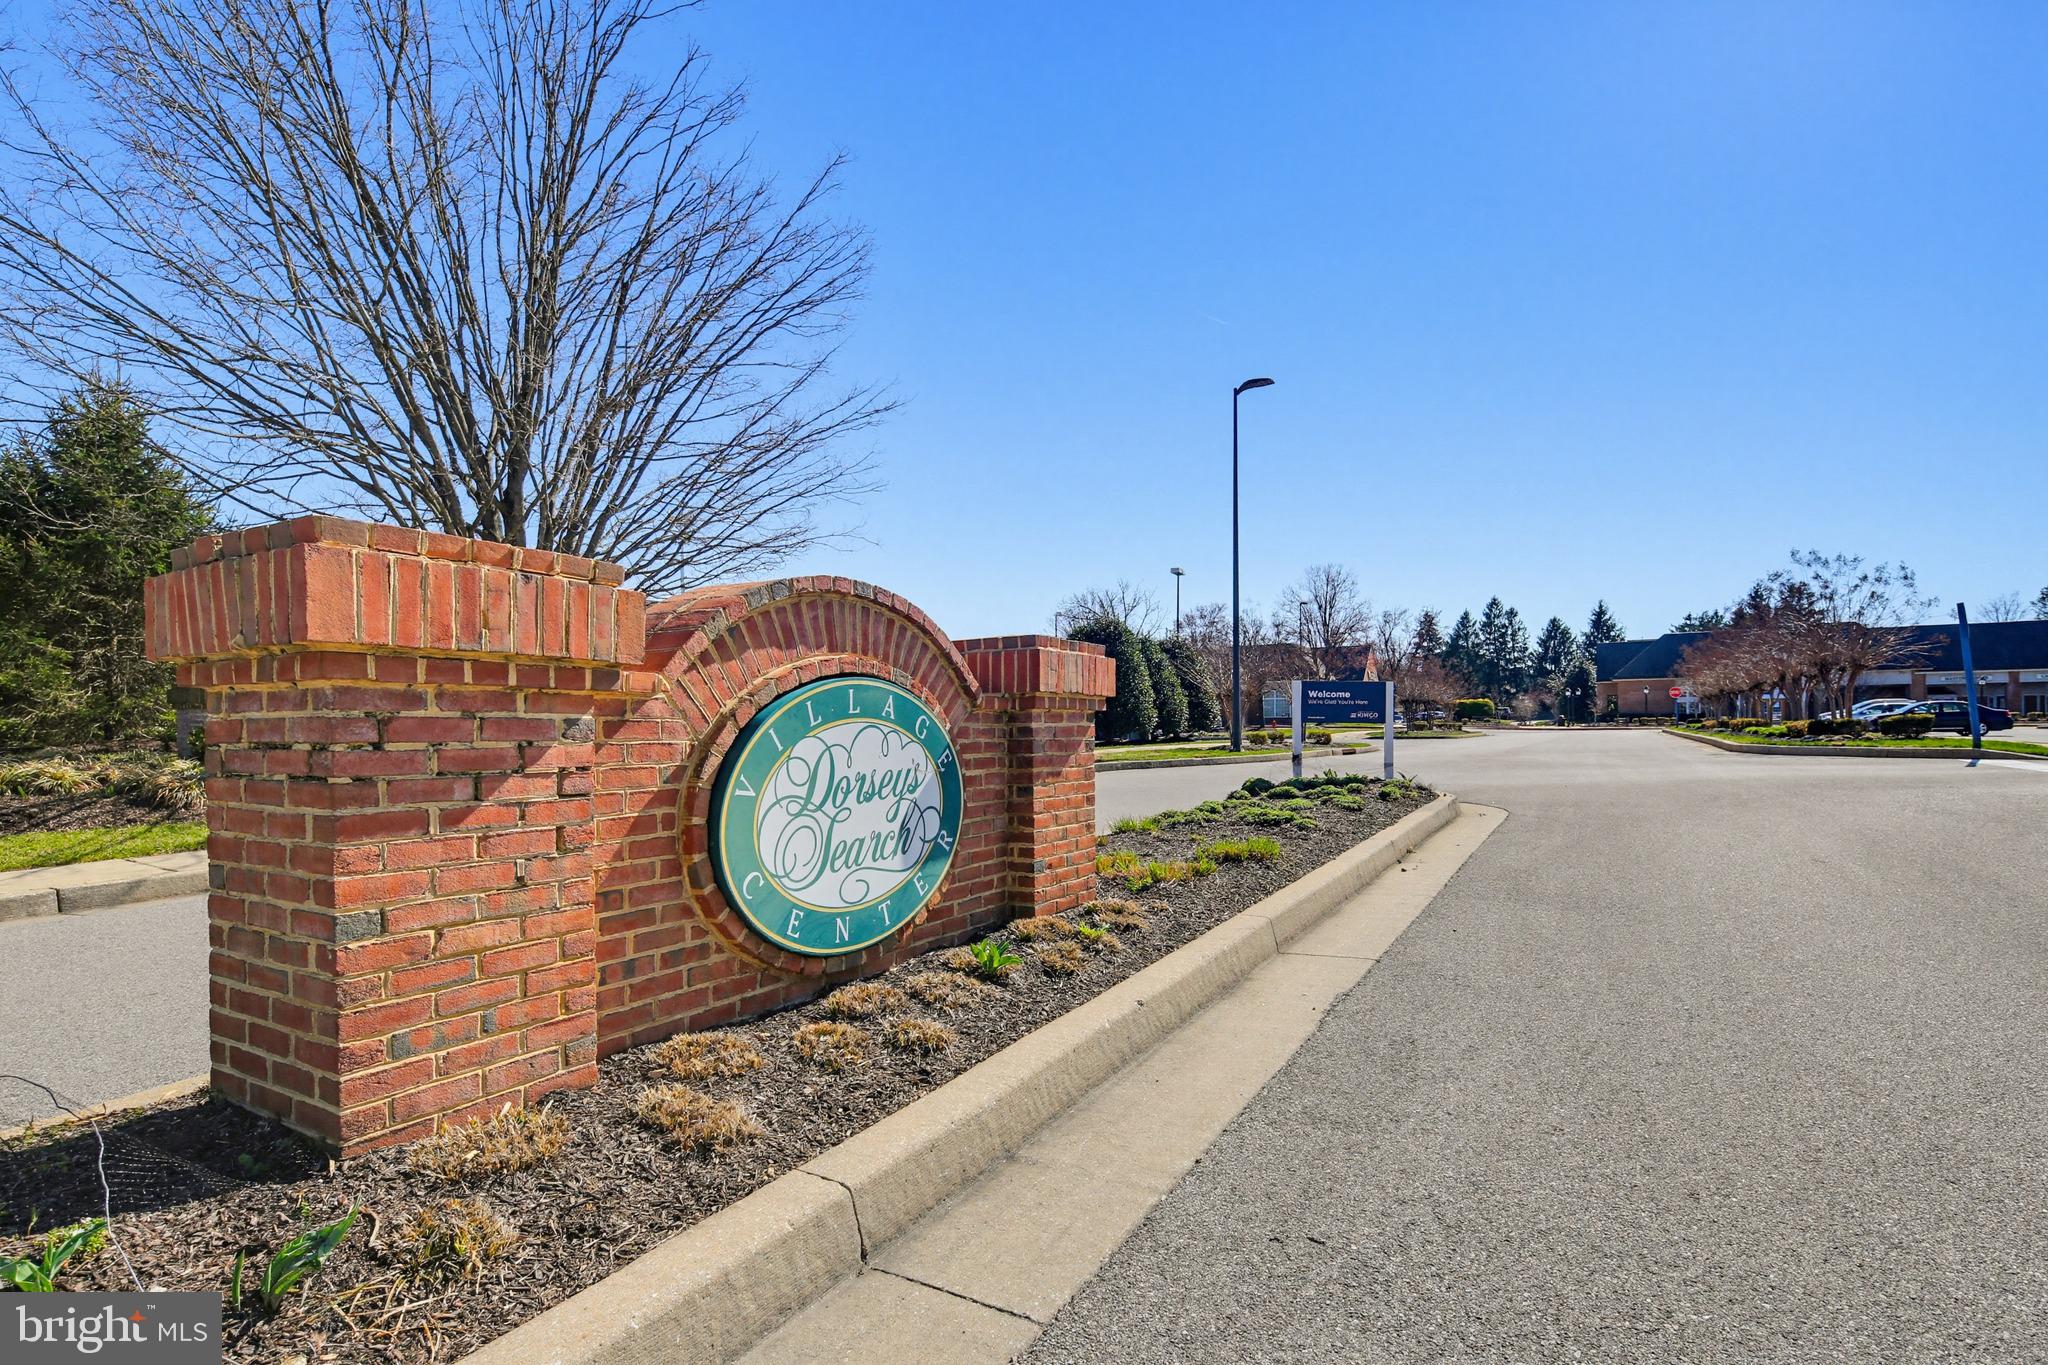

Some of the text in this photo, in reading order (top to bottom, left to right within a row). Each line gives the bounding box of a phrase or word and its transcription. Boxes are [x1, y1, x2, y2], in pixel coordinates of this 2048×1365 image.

[1308, 690, 1351, 698] Welcome
[735, 689, 953, 799] VILLAGE
[777, 732, 926, 822] Dorsey's
[742, 829, 953, 943] CENTER
[765, 797, 923, 895] Search
